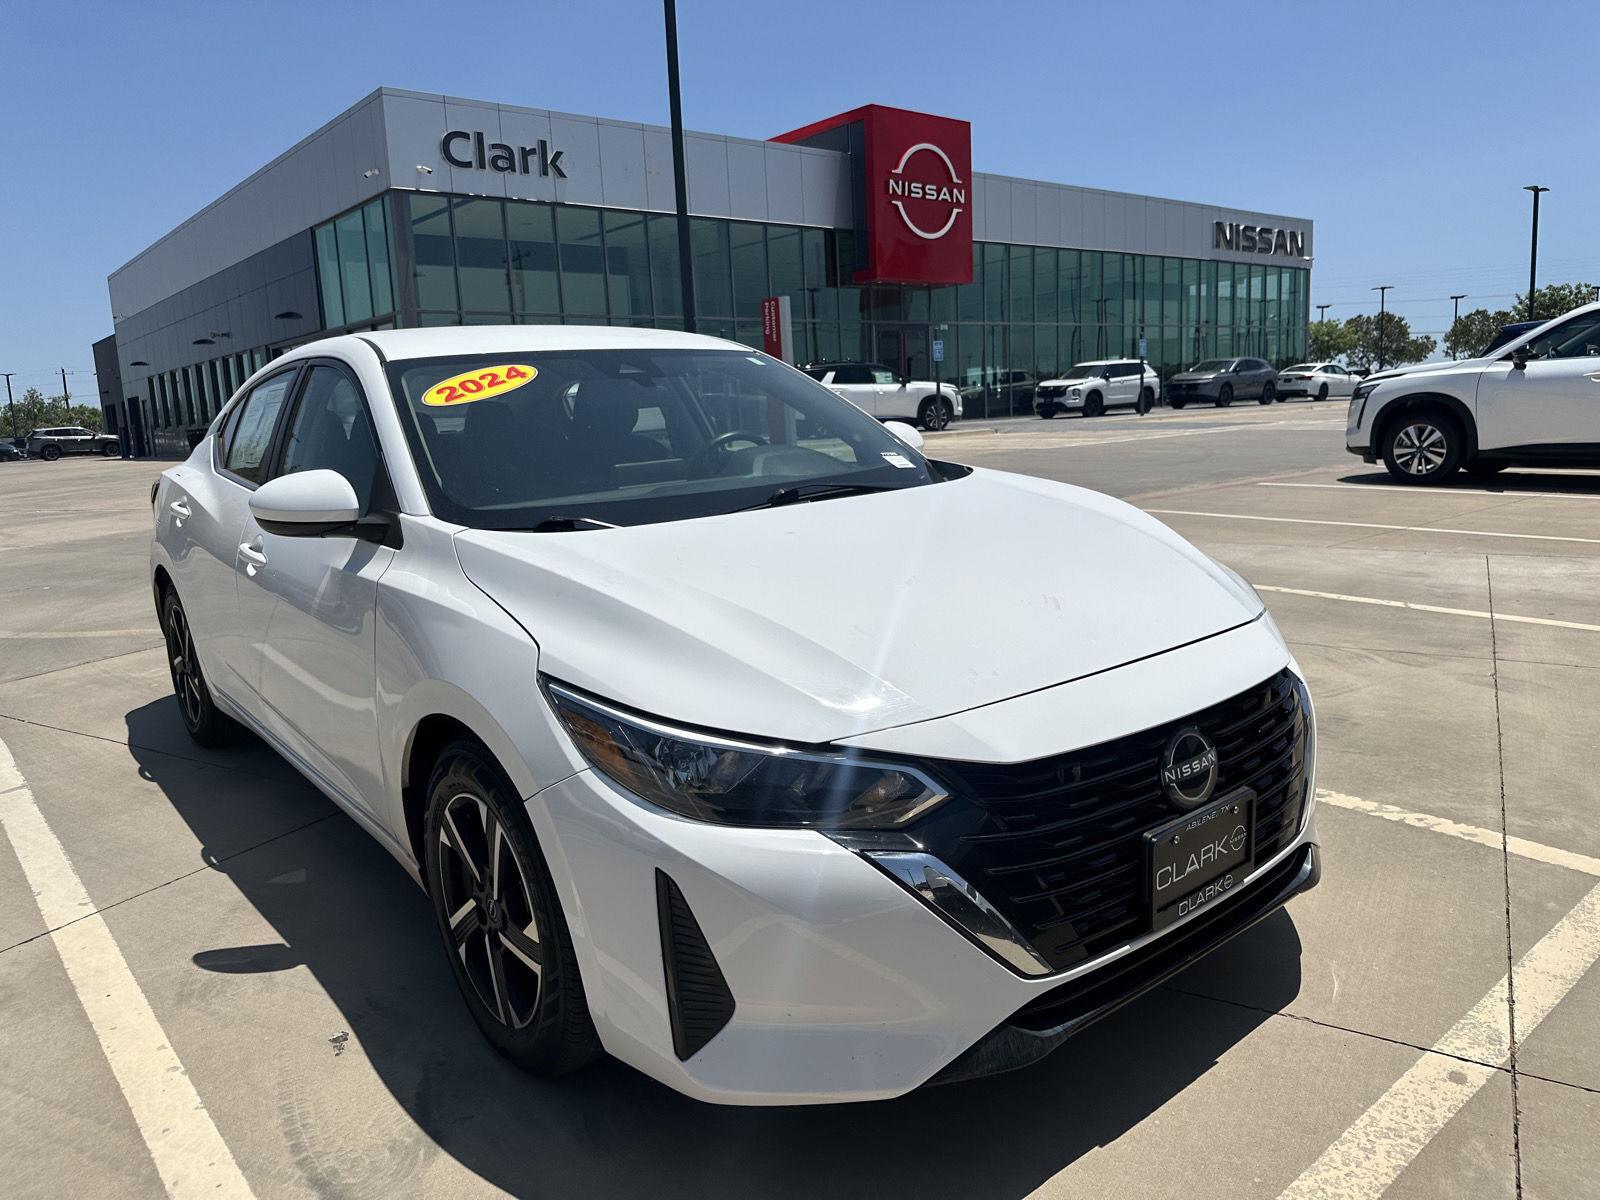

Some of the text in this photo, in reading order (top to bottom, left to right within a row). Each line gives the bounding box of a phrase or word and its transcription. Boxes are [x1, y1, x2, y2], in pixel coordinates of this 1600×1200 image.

[441, 130, 568, 179] Clark
[889, 178, 965, 204] NISSAN
[1214, 221, 1305, 257] NISSAN
[436, 366, 528, 403] 2024
[1164, 751, 1216, 782] NISSAN
[1156, 834, 1228, 890] CLARK
[1178, 879, 1223, 916] CLARK
